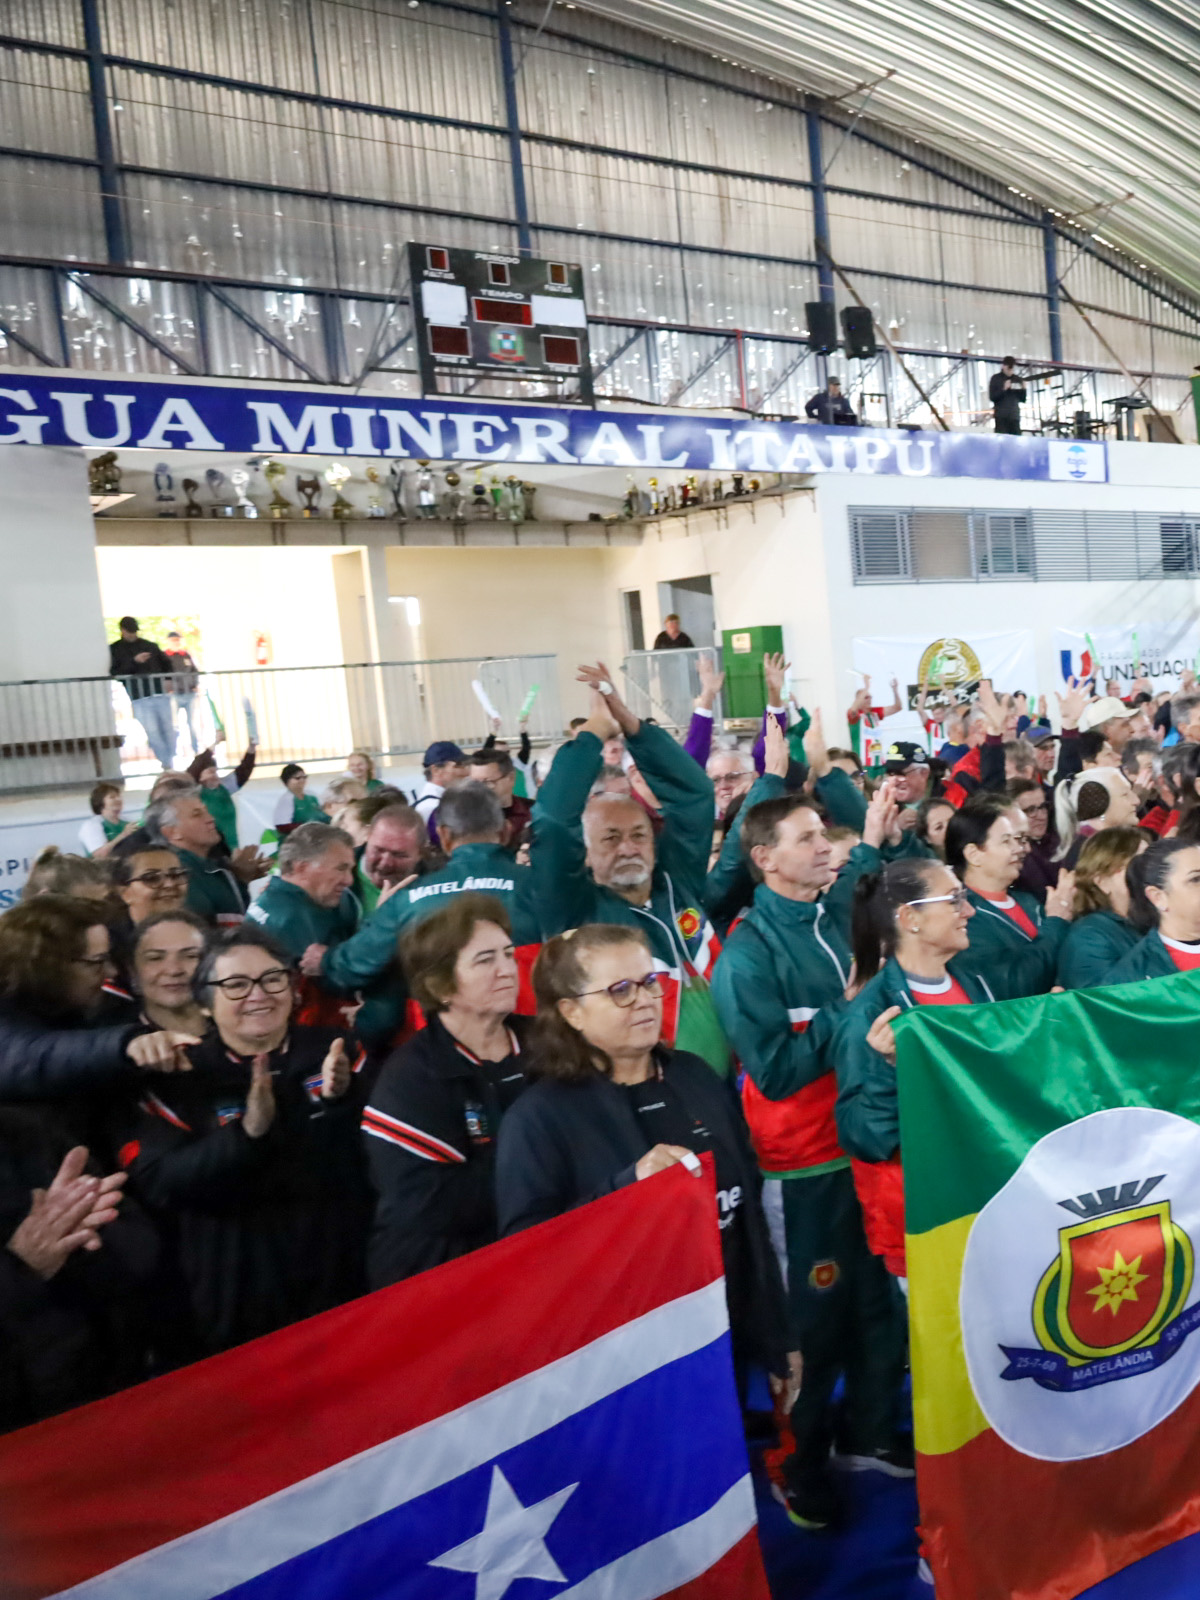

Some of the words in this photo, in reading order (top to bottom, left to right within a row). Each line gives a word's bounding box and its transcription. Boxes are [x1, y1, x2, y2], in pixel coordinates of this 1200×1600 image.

[480, 288, 524, 300] TEMPO
[246, 401, 690, 468] MINERAL
[706, 428, 936, 477] ITAIPU
[408, 875, 515, 904] MATELÂNDIA
[1072, 1350, 1155, 1381] MATELÂNDIA
